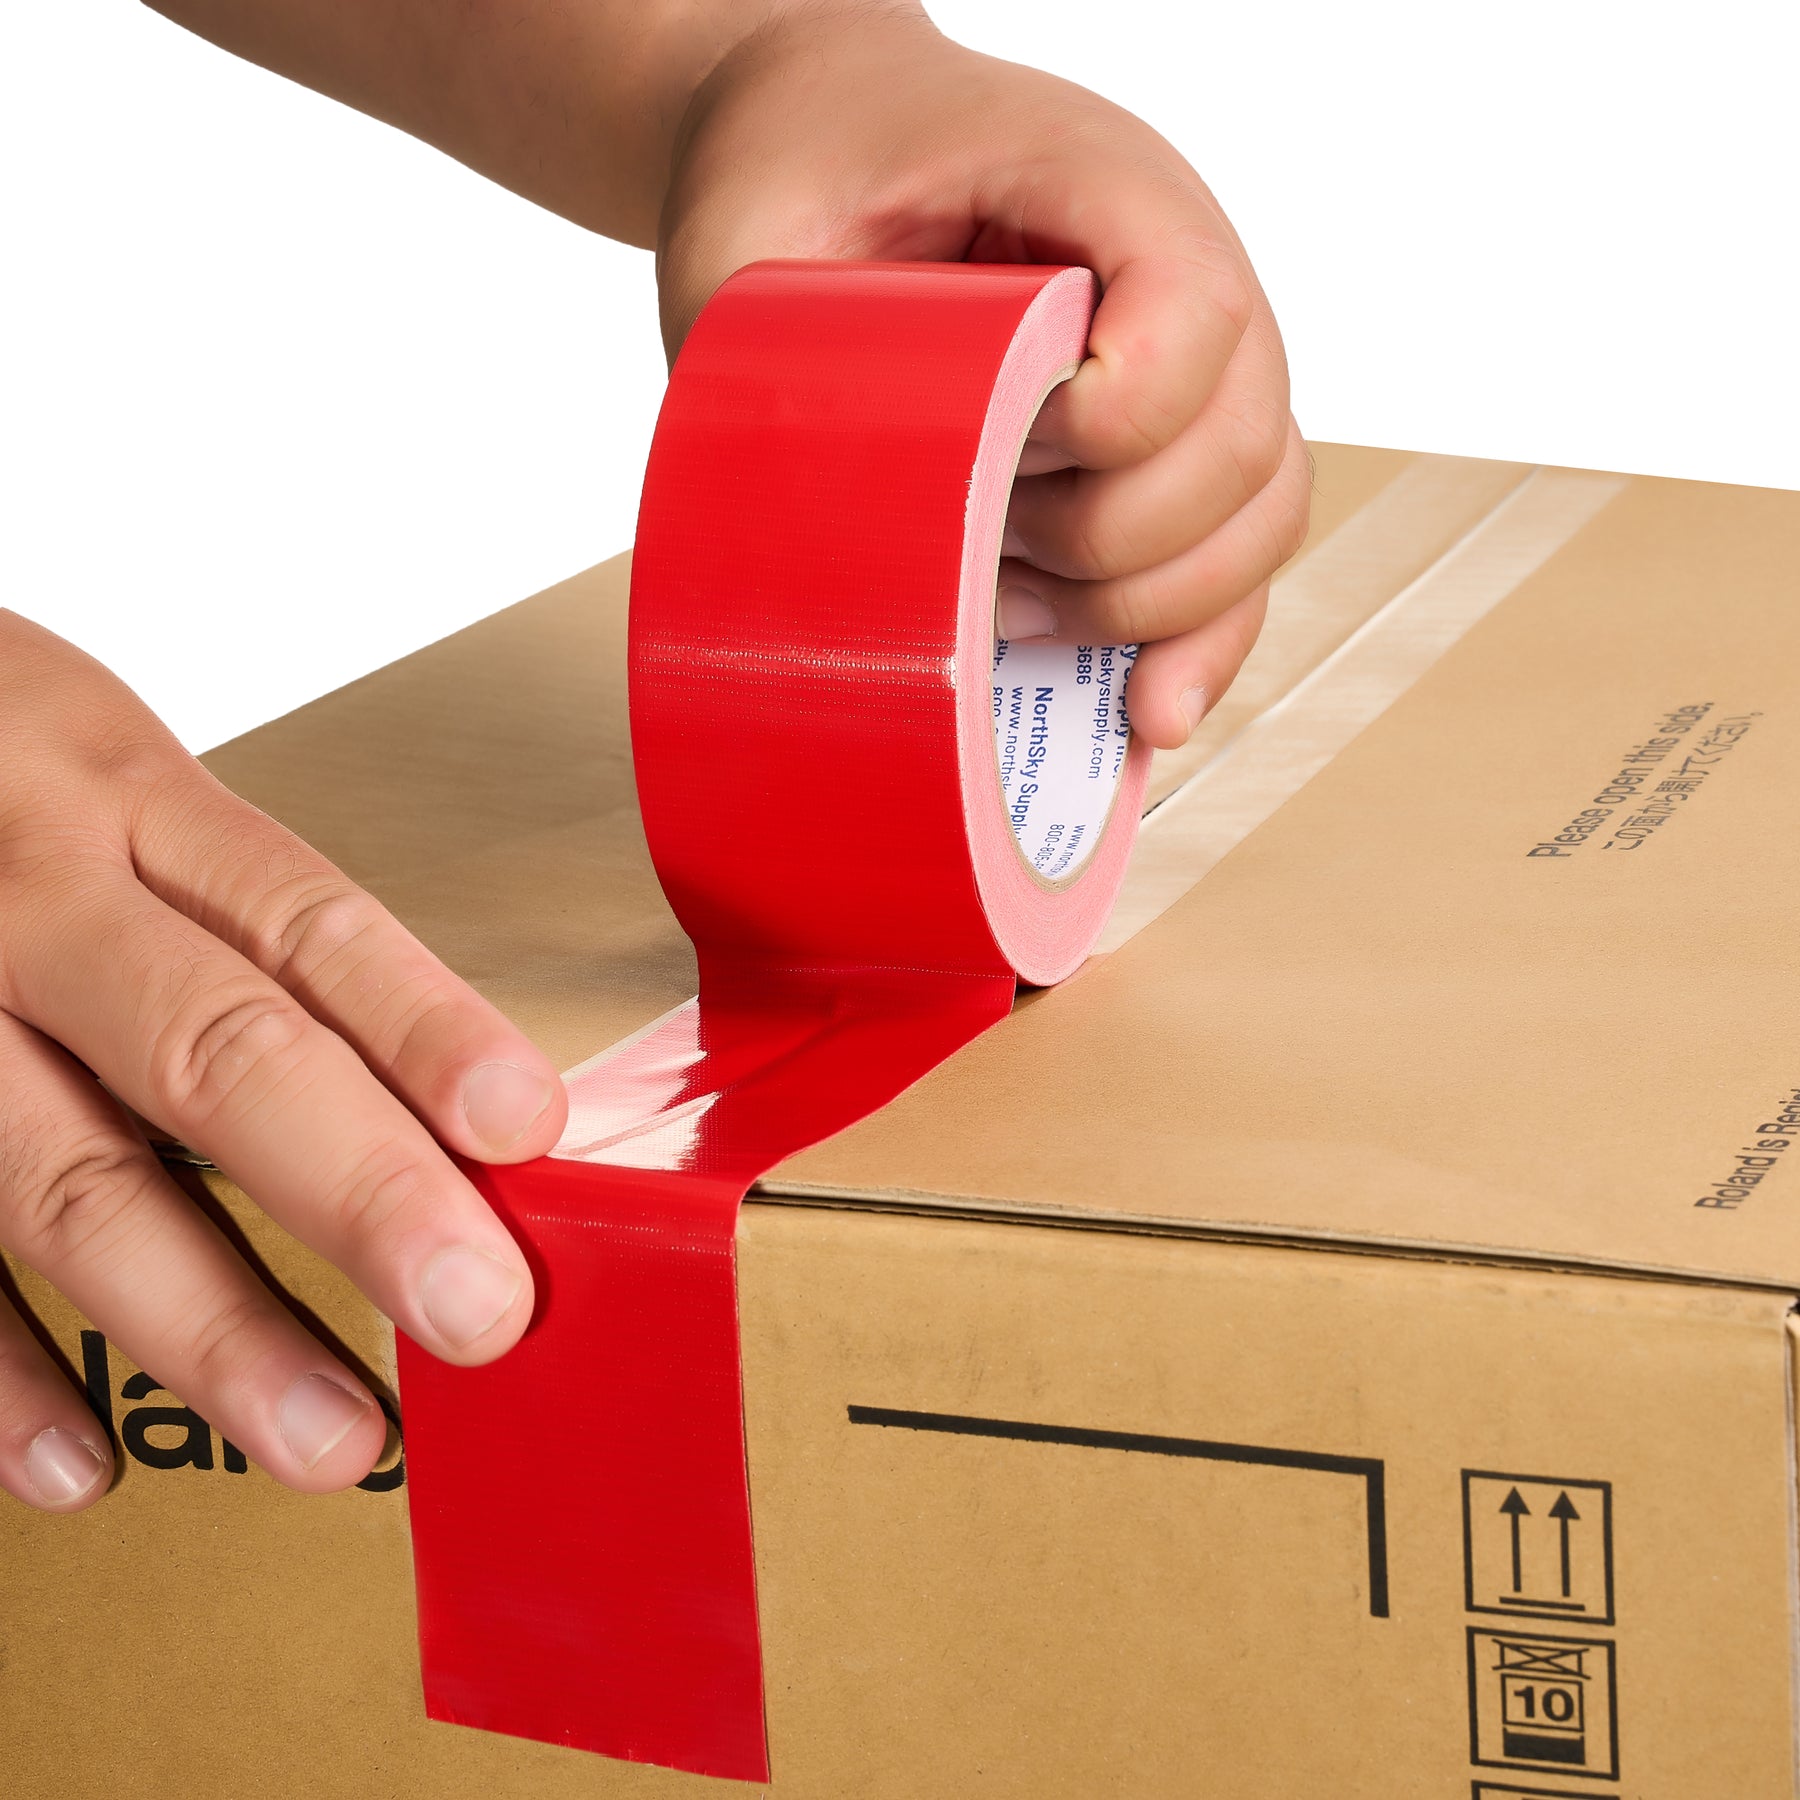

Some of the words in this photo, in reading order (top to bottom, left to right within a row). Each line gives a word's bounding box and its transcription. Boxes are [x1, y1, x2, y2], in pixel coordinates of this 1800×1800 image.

[1020, 686, 1054, 779] NorthSky
[1623, 737, 1681, 765] this
[1593, 767, 1654, 804] open
[1526, 808, 1614, 857] Please
[1694, 1155, 1778, 1209] Roland
[1742, 1138, 1790, 1152] is
[1514, 1685, 1574, 1722] 10
